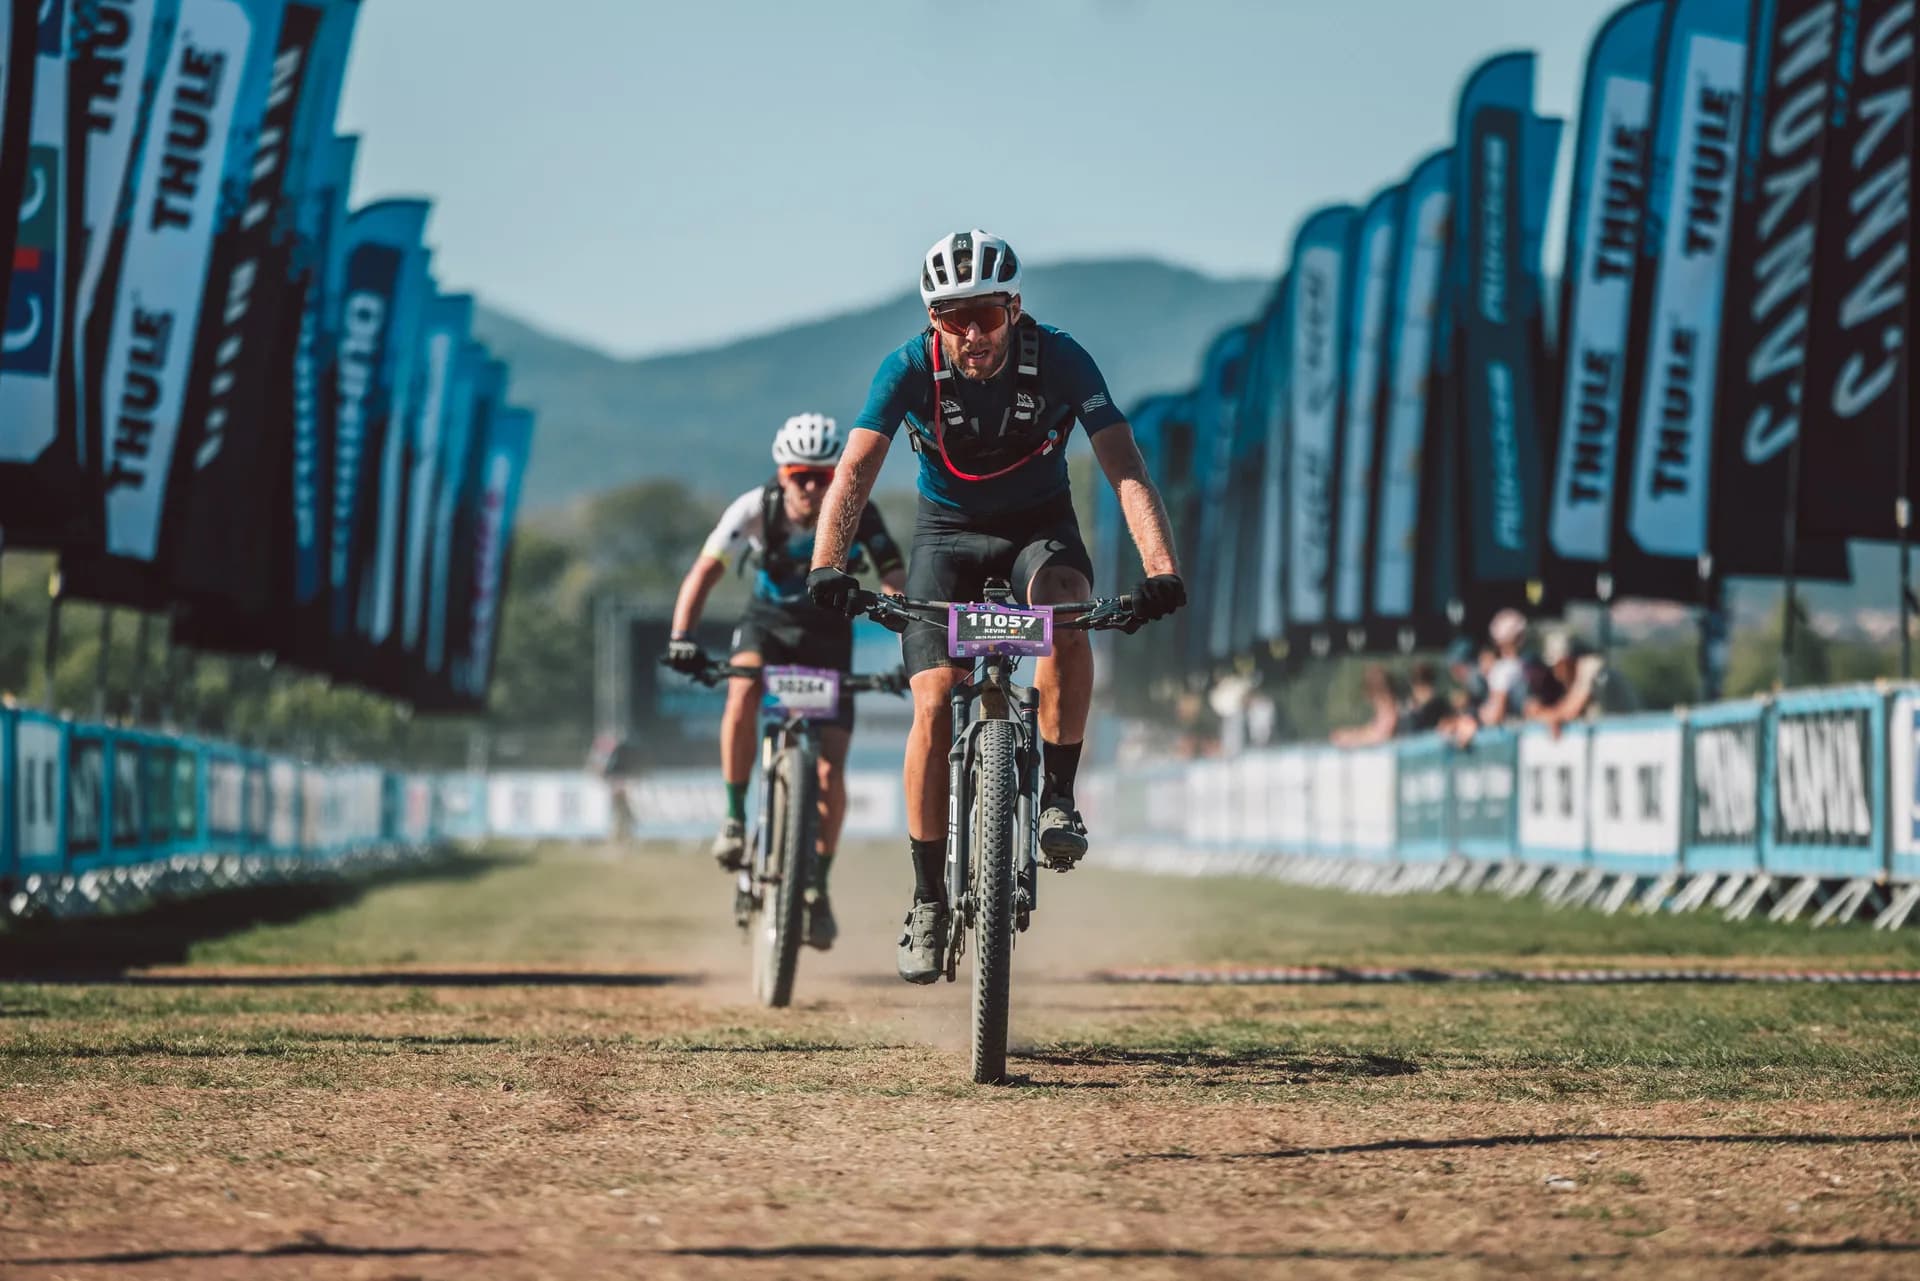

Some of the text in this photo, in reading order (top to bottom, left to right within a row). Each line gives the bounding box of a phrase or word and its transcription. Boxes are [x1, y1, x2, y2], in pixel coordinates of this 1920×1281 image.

[149, 45, 228, 234] THULE
[1592, 118, 1646, 285] THULE
[1685, 84, 1742, 260] THULE
[107, 304, 176, 492] THULE
[1565, 347, 1617, 509] THULE
[1651, 326, 1698, 501] THULE
[966, 613, 1036, 629] 11057
